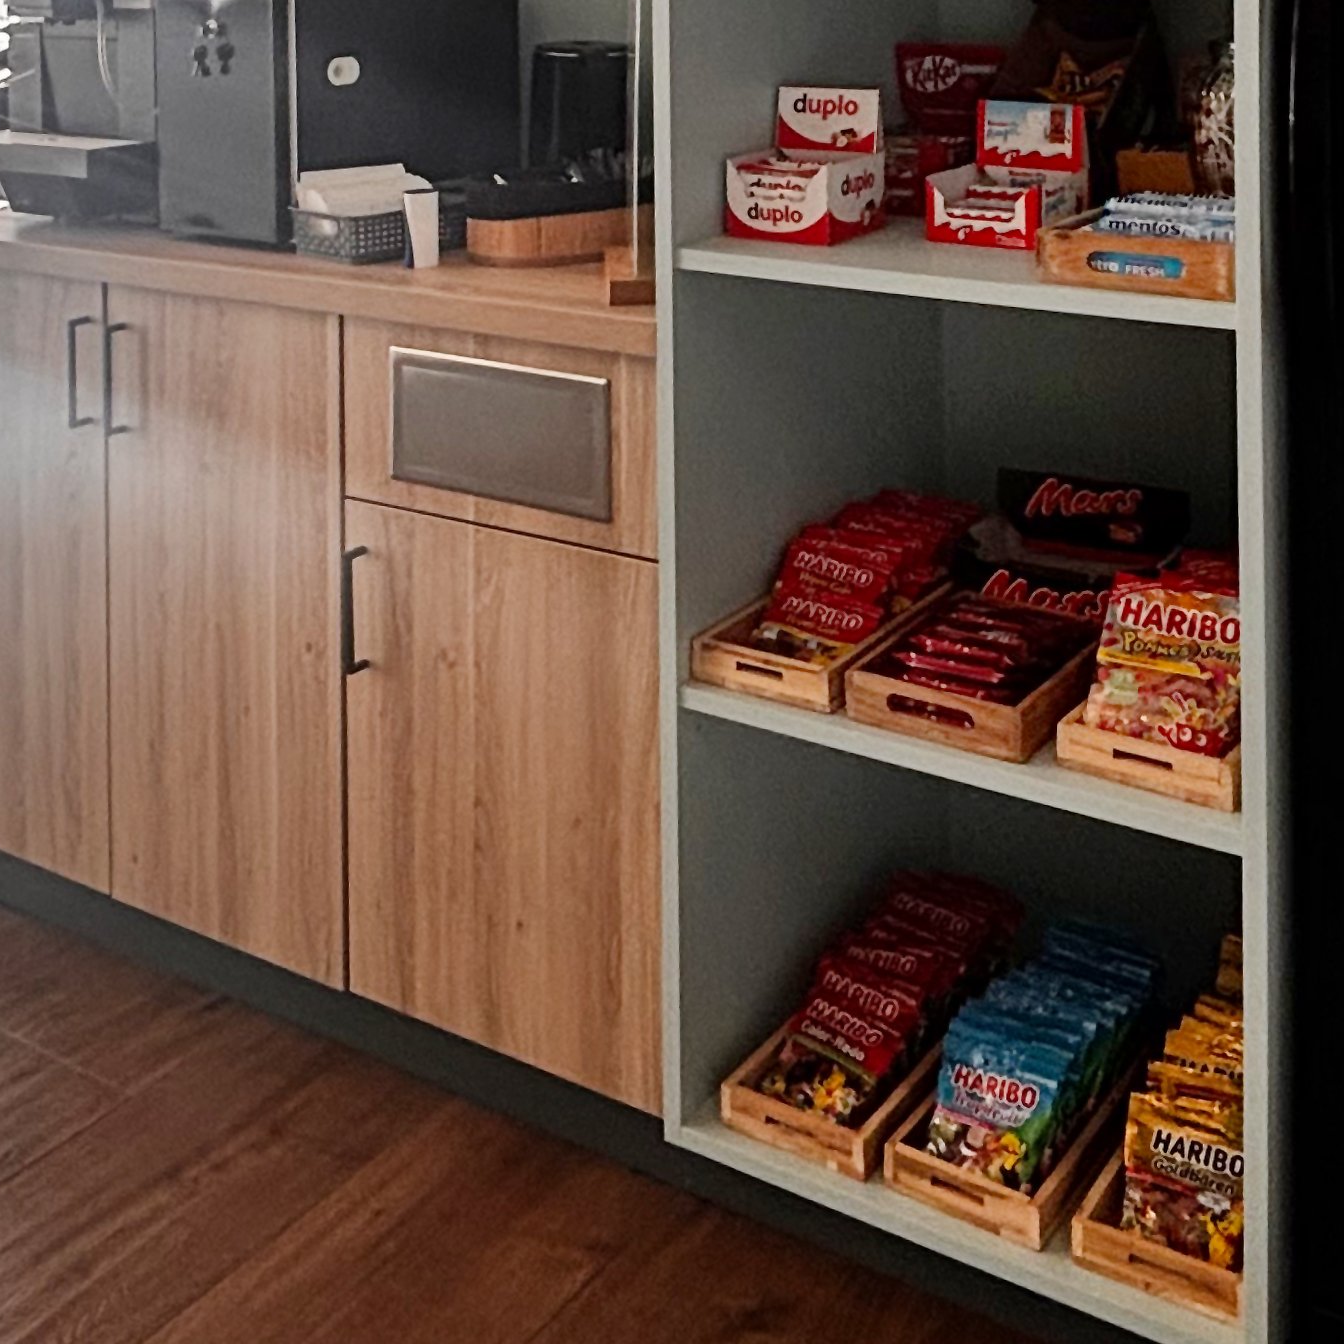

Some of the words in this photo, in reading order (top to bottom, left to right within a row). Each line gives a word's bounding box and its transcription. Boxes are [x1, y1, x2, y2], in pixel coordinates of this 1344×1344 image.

[793, 93, 859, 121] duplo
[840, 168, 876, 200] duplo
[747, 202, 804, 227] duplo
[1108, 218, 1182, 237] mentos
[1126, 264, 1166, 277] FRESH
[1024, 477, 1144, 518] Mars
[793, 550, 874, 588] HARIBO
[782, 595, 865, 631] HARIBO
[1119, 597, 1241, 645] HARIBO
[822, 970, 900, 1022] HARIBO
[805, 998, 884, 1047] HARIBO
[953, 1064, 1039, 1110] HARIBO
[1152, 1128, 1245, 1178] HARIBO
